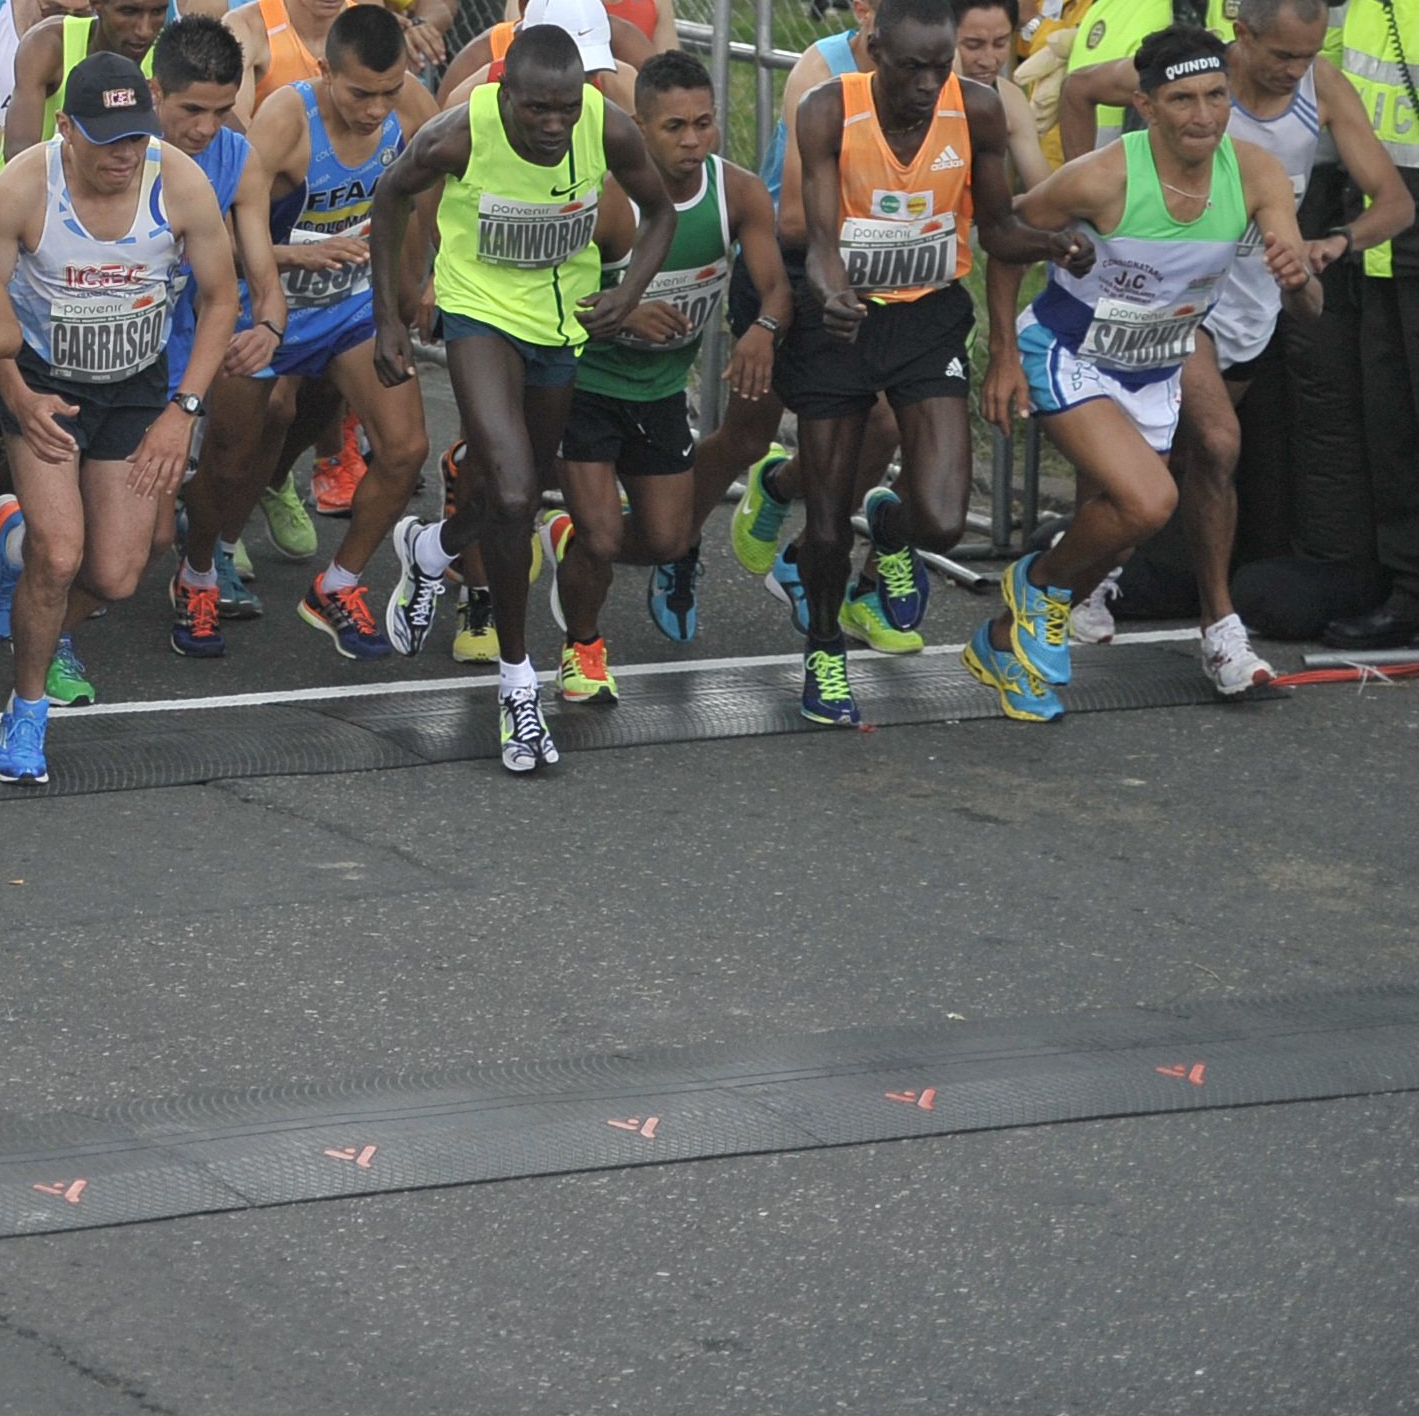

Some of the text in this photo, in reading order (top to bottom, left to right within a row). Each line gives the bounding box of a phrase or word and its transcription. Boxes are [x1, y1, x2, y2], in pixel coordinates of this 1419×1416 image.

[930, 159, 965, 172] adidas
[491, 204, 550, 215] porvenir
[479, 214, 594, 259] KAMWOROR
[854, 228, 911, 239] porvenir
[849, 240, 948, 285] BUNDI
[64, 304, 123, 315] porvenir
[1109, 308, 1166, 321] porvenir
[53, 310, 163, 370] CARRASCO
